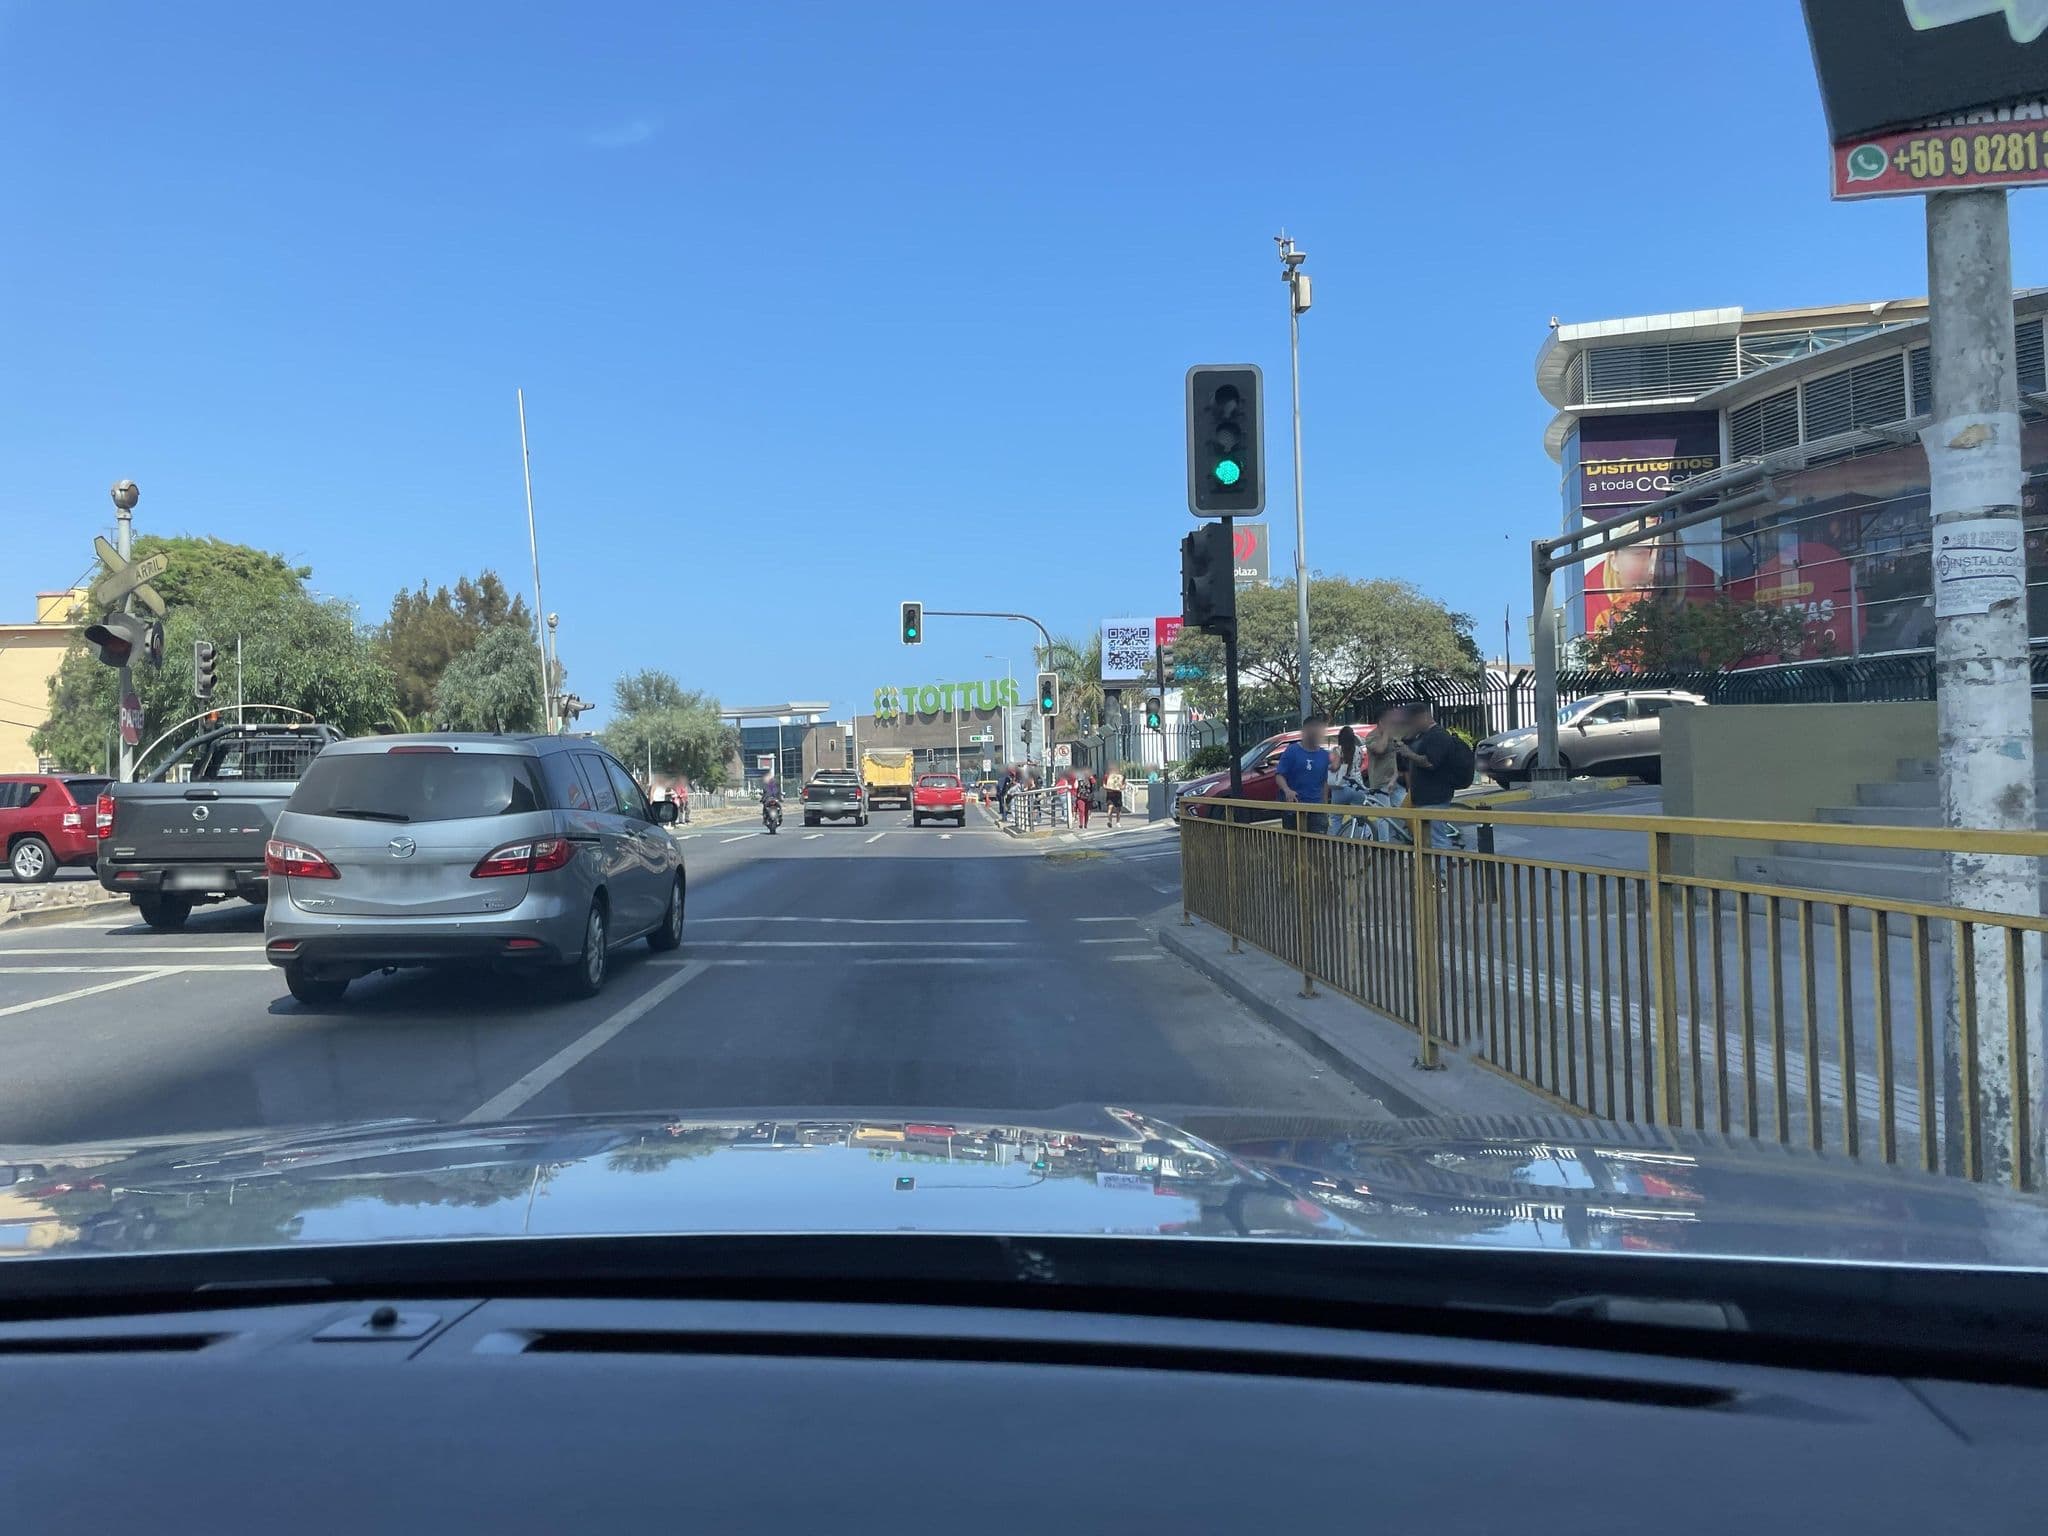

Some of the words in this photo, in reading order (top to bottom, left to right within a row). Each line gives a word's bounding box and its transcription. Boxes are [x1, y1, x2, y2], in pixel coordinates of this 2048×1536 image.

[1893, 137, 1945, 178] +56
[1950, 136, 1968, 176] 9
[1974, 131, 2038, 174] 8281
[1586, 457, 1714, 476] Disfrutemos
[1588, 482, 1598, 492] a
[1601, 479, 1634, 491] toda
[902, 678, 1020, 716] TOTTUS
